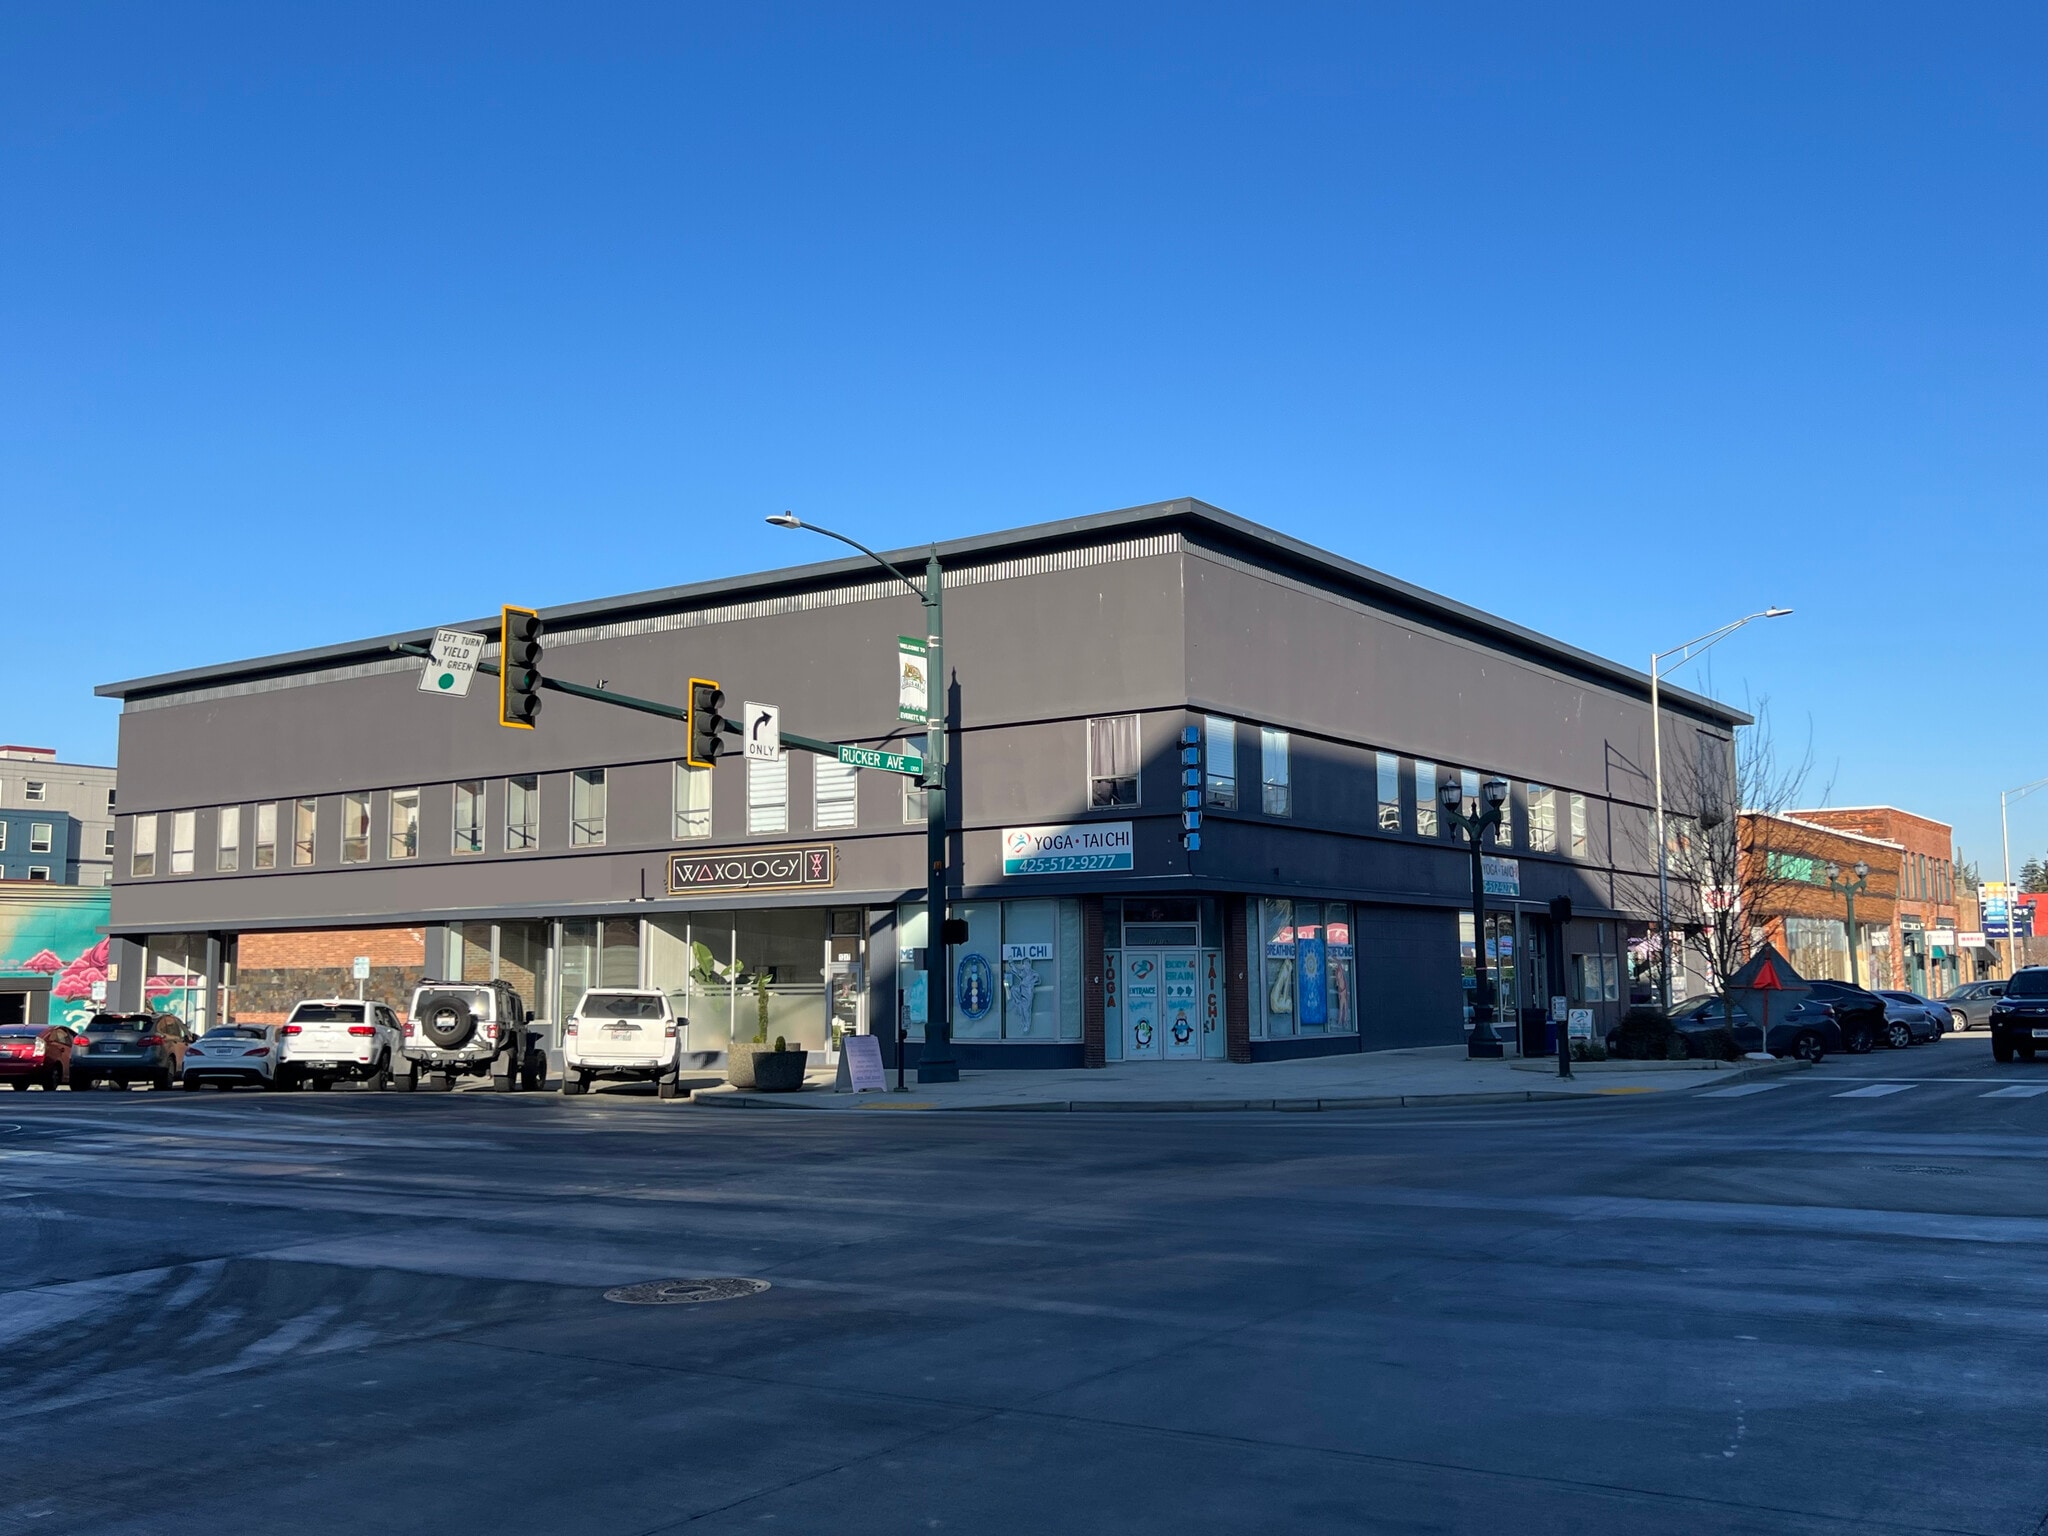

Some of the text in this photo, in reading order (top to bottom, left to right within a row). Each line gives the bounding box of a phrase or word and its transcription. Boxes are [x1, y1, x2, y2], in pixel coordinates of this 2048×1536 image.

[438, 633, 481, 647] LEFT TURN
[443, 646, 469, 659] YIELD
[447, 660, 473, 671] GREEN
[749, 743, 775, 757] ONLY
[841, 749, 905, 771] RUCKER AVE
[1034, 835, 1073, 851] YOGA
[676, 858, 799, 883] WAXOLOGY
[1019, 855, 1116, 872] 425-512-9277
[1011, 945, 1047, 958] TAI CHI
[1165, 971, 1194, 980] BRAIN
